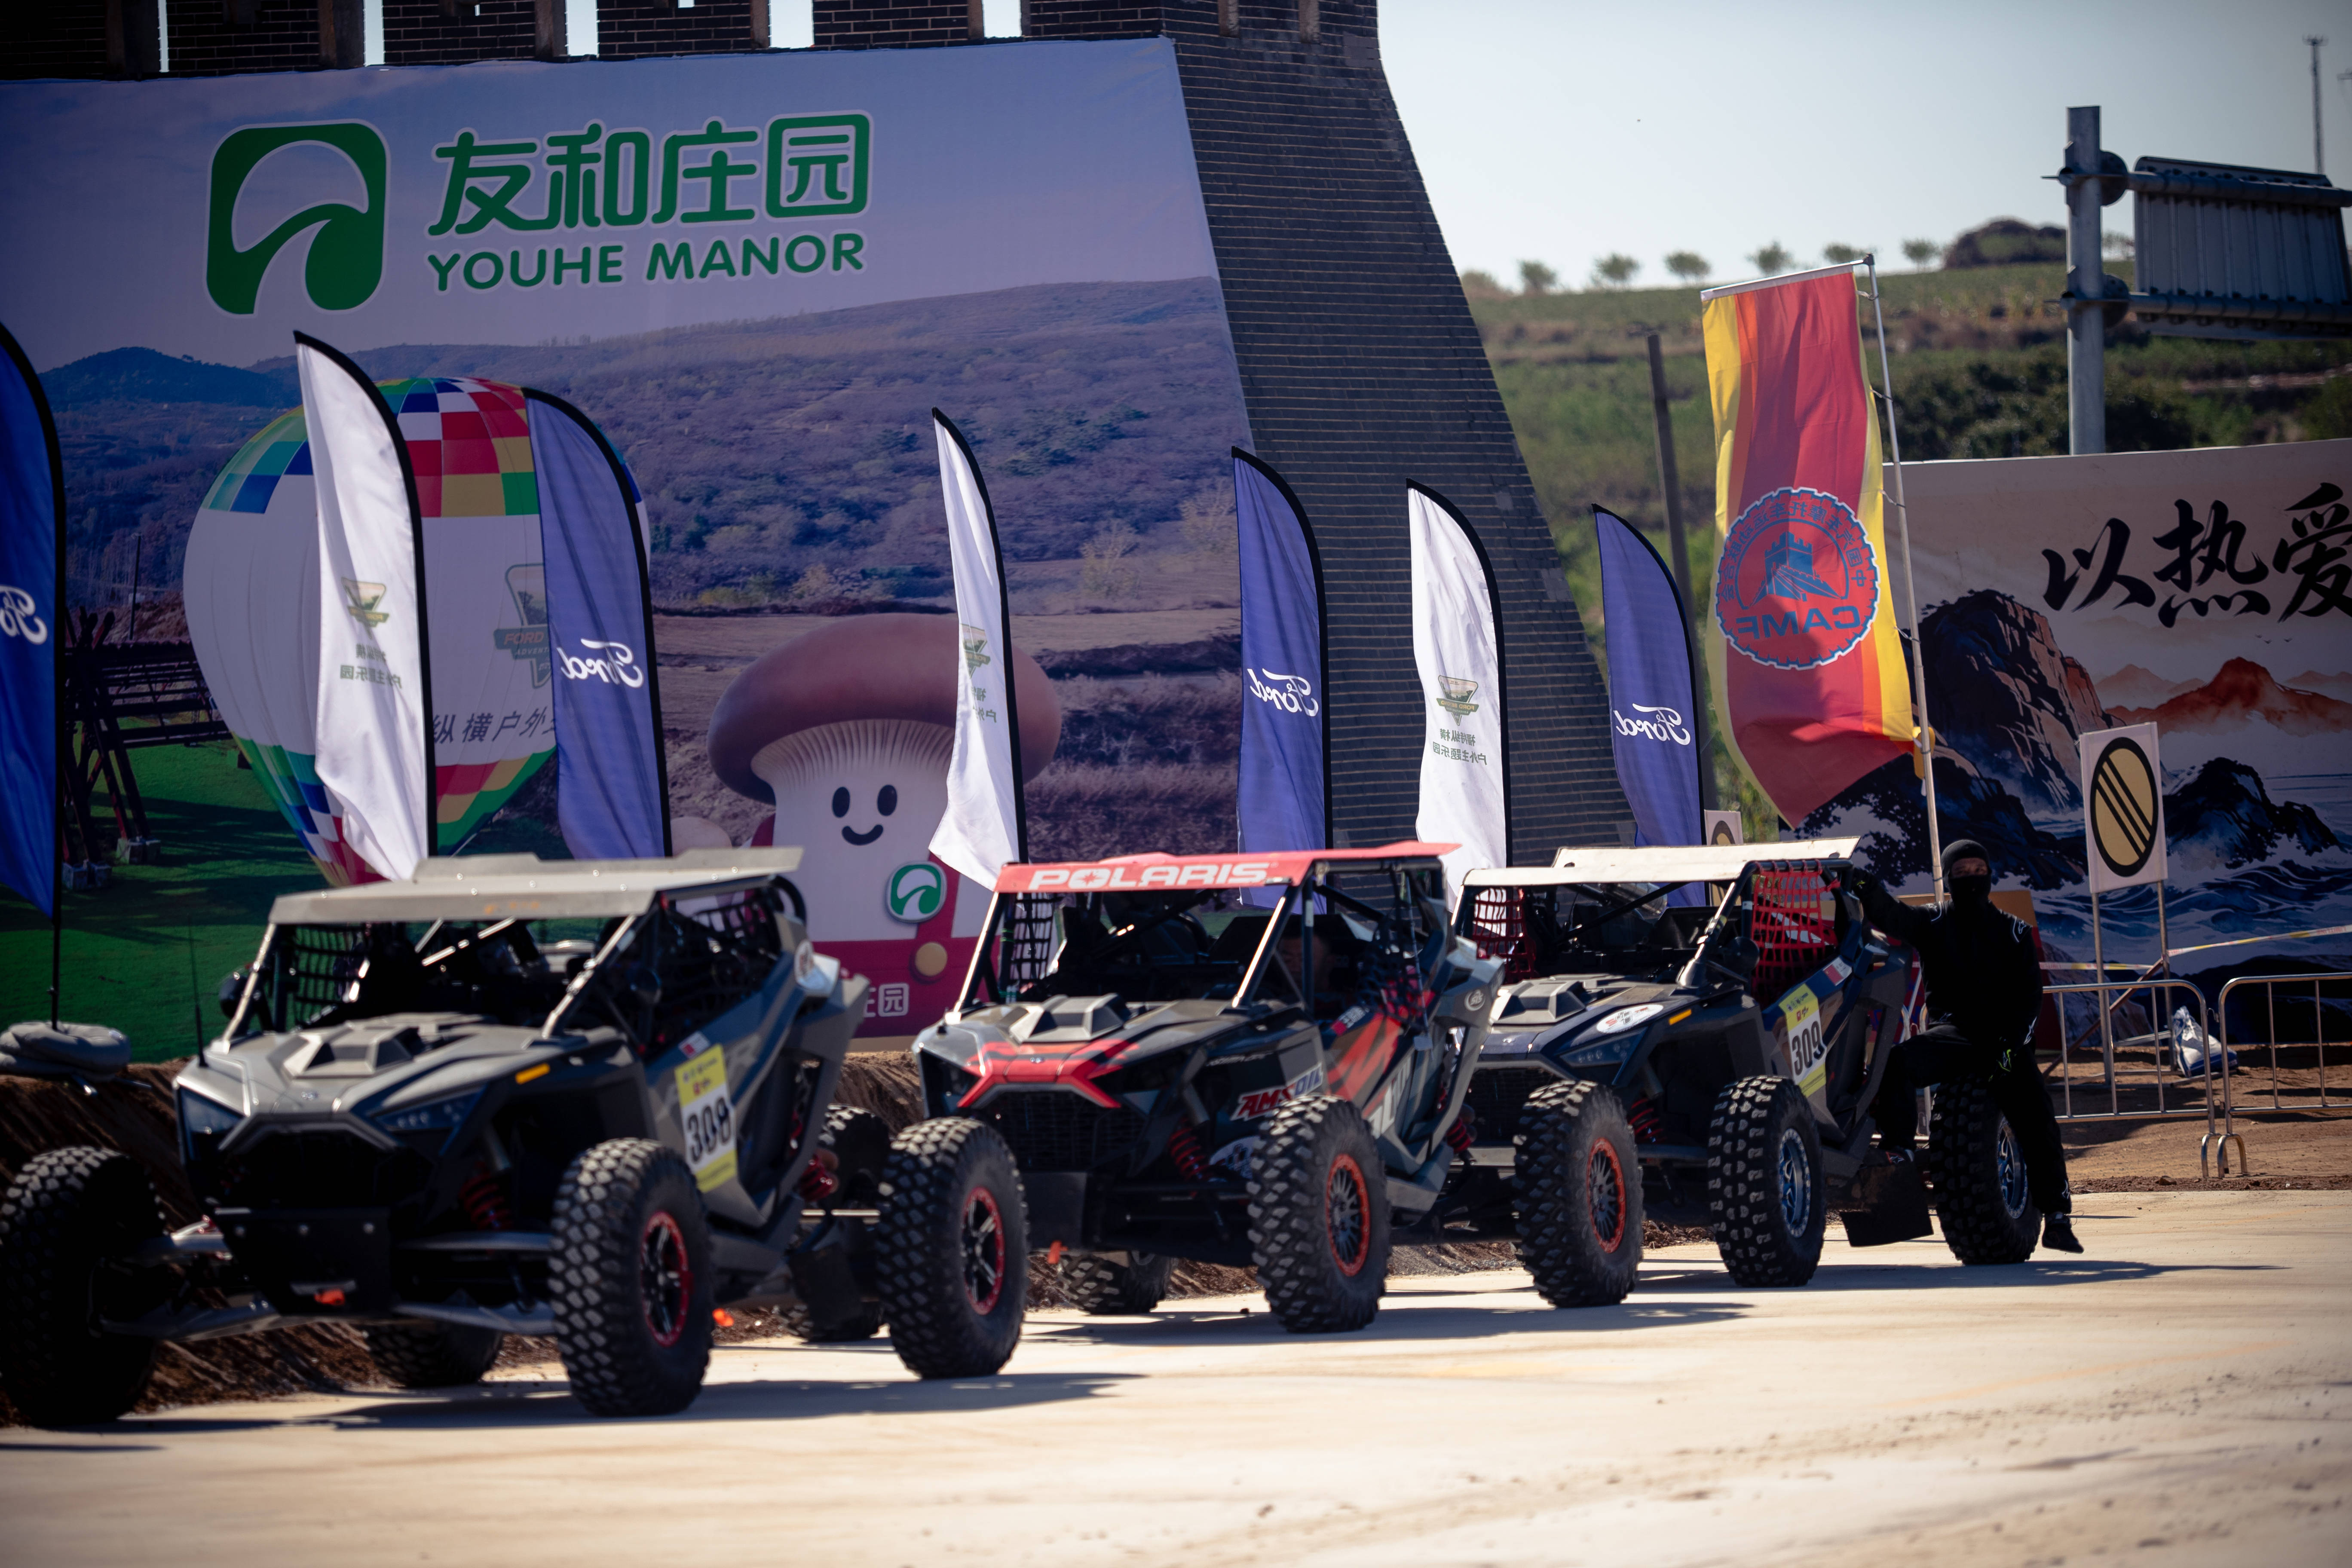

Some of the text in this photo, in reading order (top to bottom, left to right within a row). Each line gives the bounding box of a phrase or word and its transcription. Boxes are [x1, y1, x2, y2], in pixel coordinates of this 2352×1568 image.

[427, 113, 870, 236] 友和庄园
[428, 233, 864, 291] YOUHE MANOR
[2041, 482, 2352, 628] 以热爱
[503, 631, 545, 645] FORD
[1028, 862, 1271, 891] POLARIS
[1792, 1020, 1825, 1076] 309
[1235, 1065, 1322, 1119] AMSOIL
[688, 1096, 732, 1164] 308
